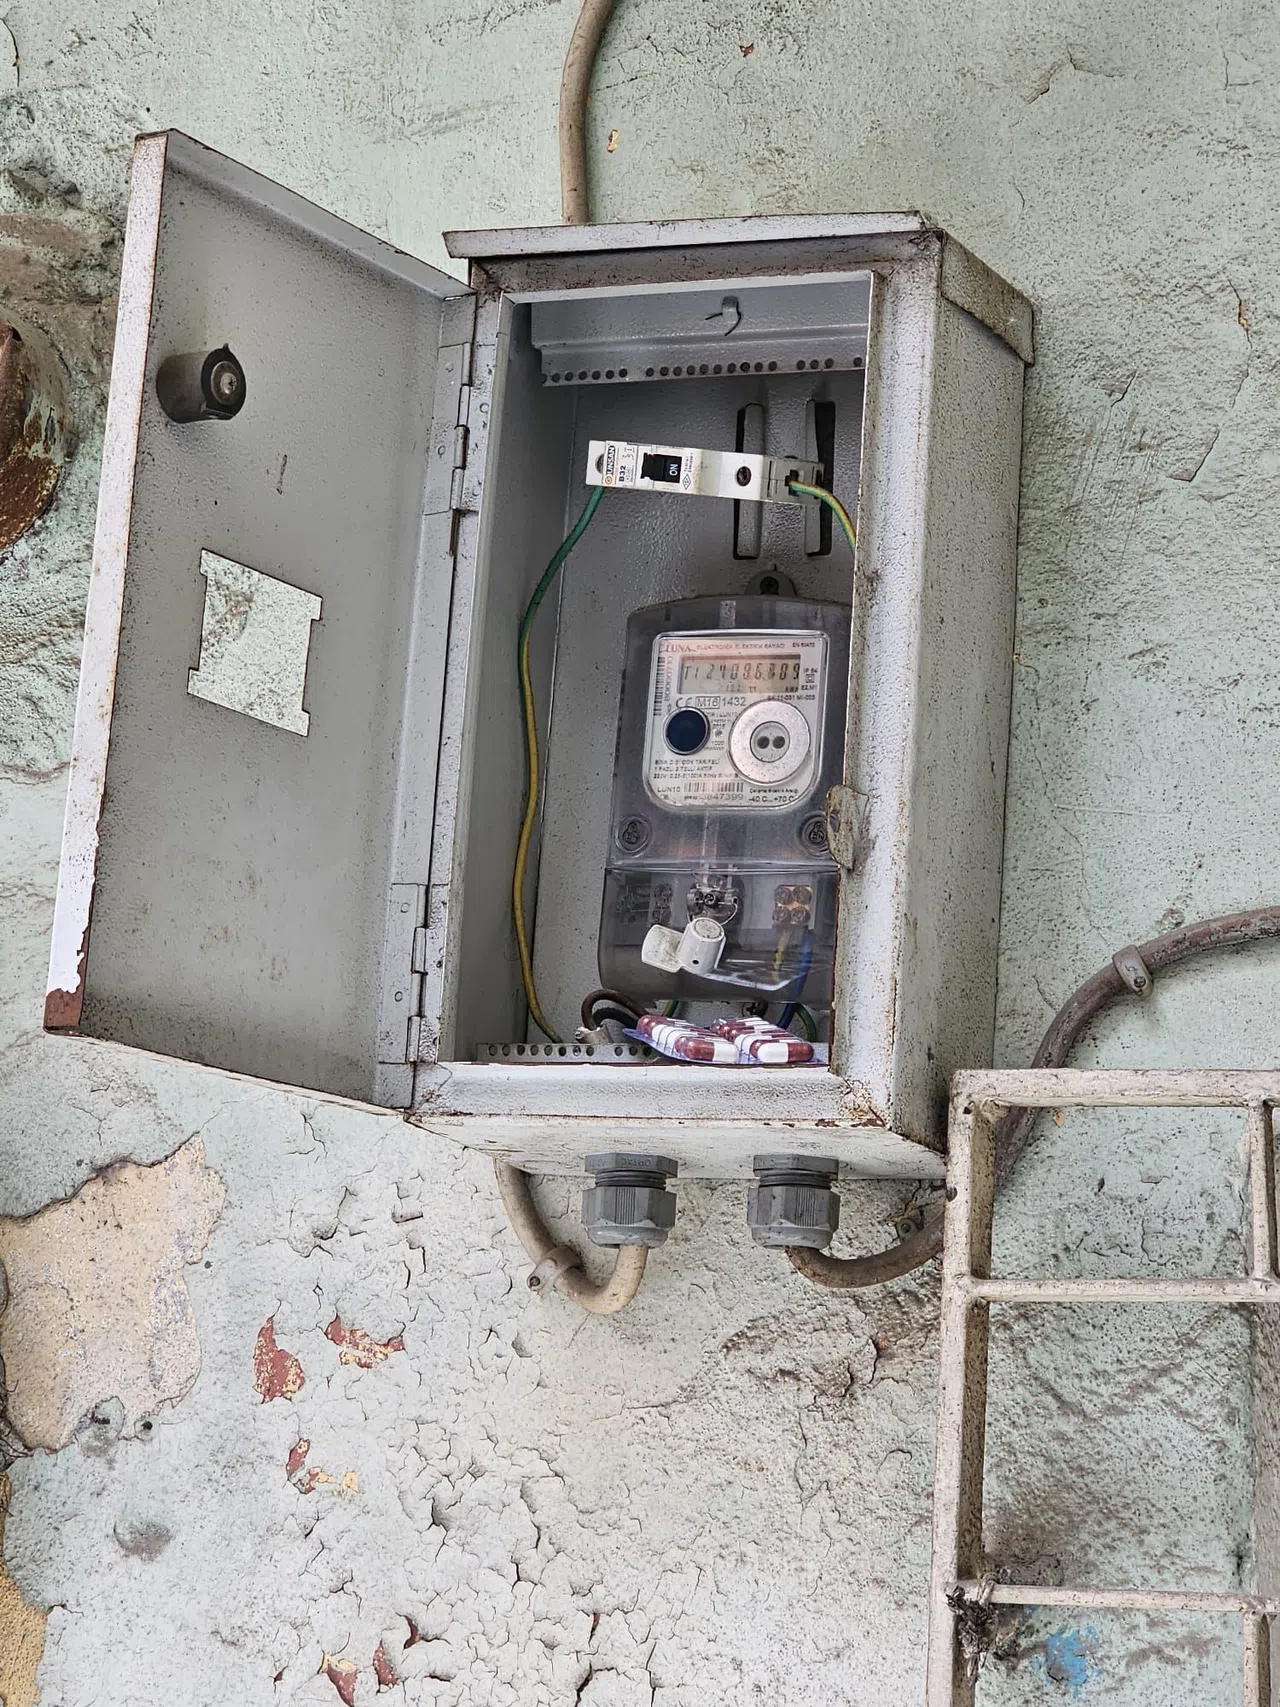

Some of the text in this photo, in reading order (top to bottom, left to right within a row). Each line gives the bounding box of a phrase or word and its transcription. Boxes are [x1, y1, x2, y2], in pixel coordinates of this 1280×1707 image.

[618, 465, 626, 482] B32
[669, 463, 679, 476] ON
[665, 643, 692, 653] LUNA
[698, 698, 718, 707] M16
[722, 697, 746, 707] 1432
